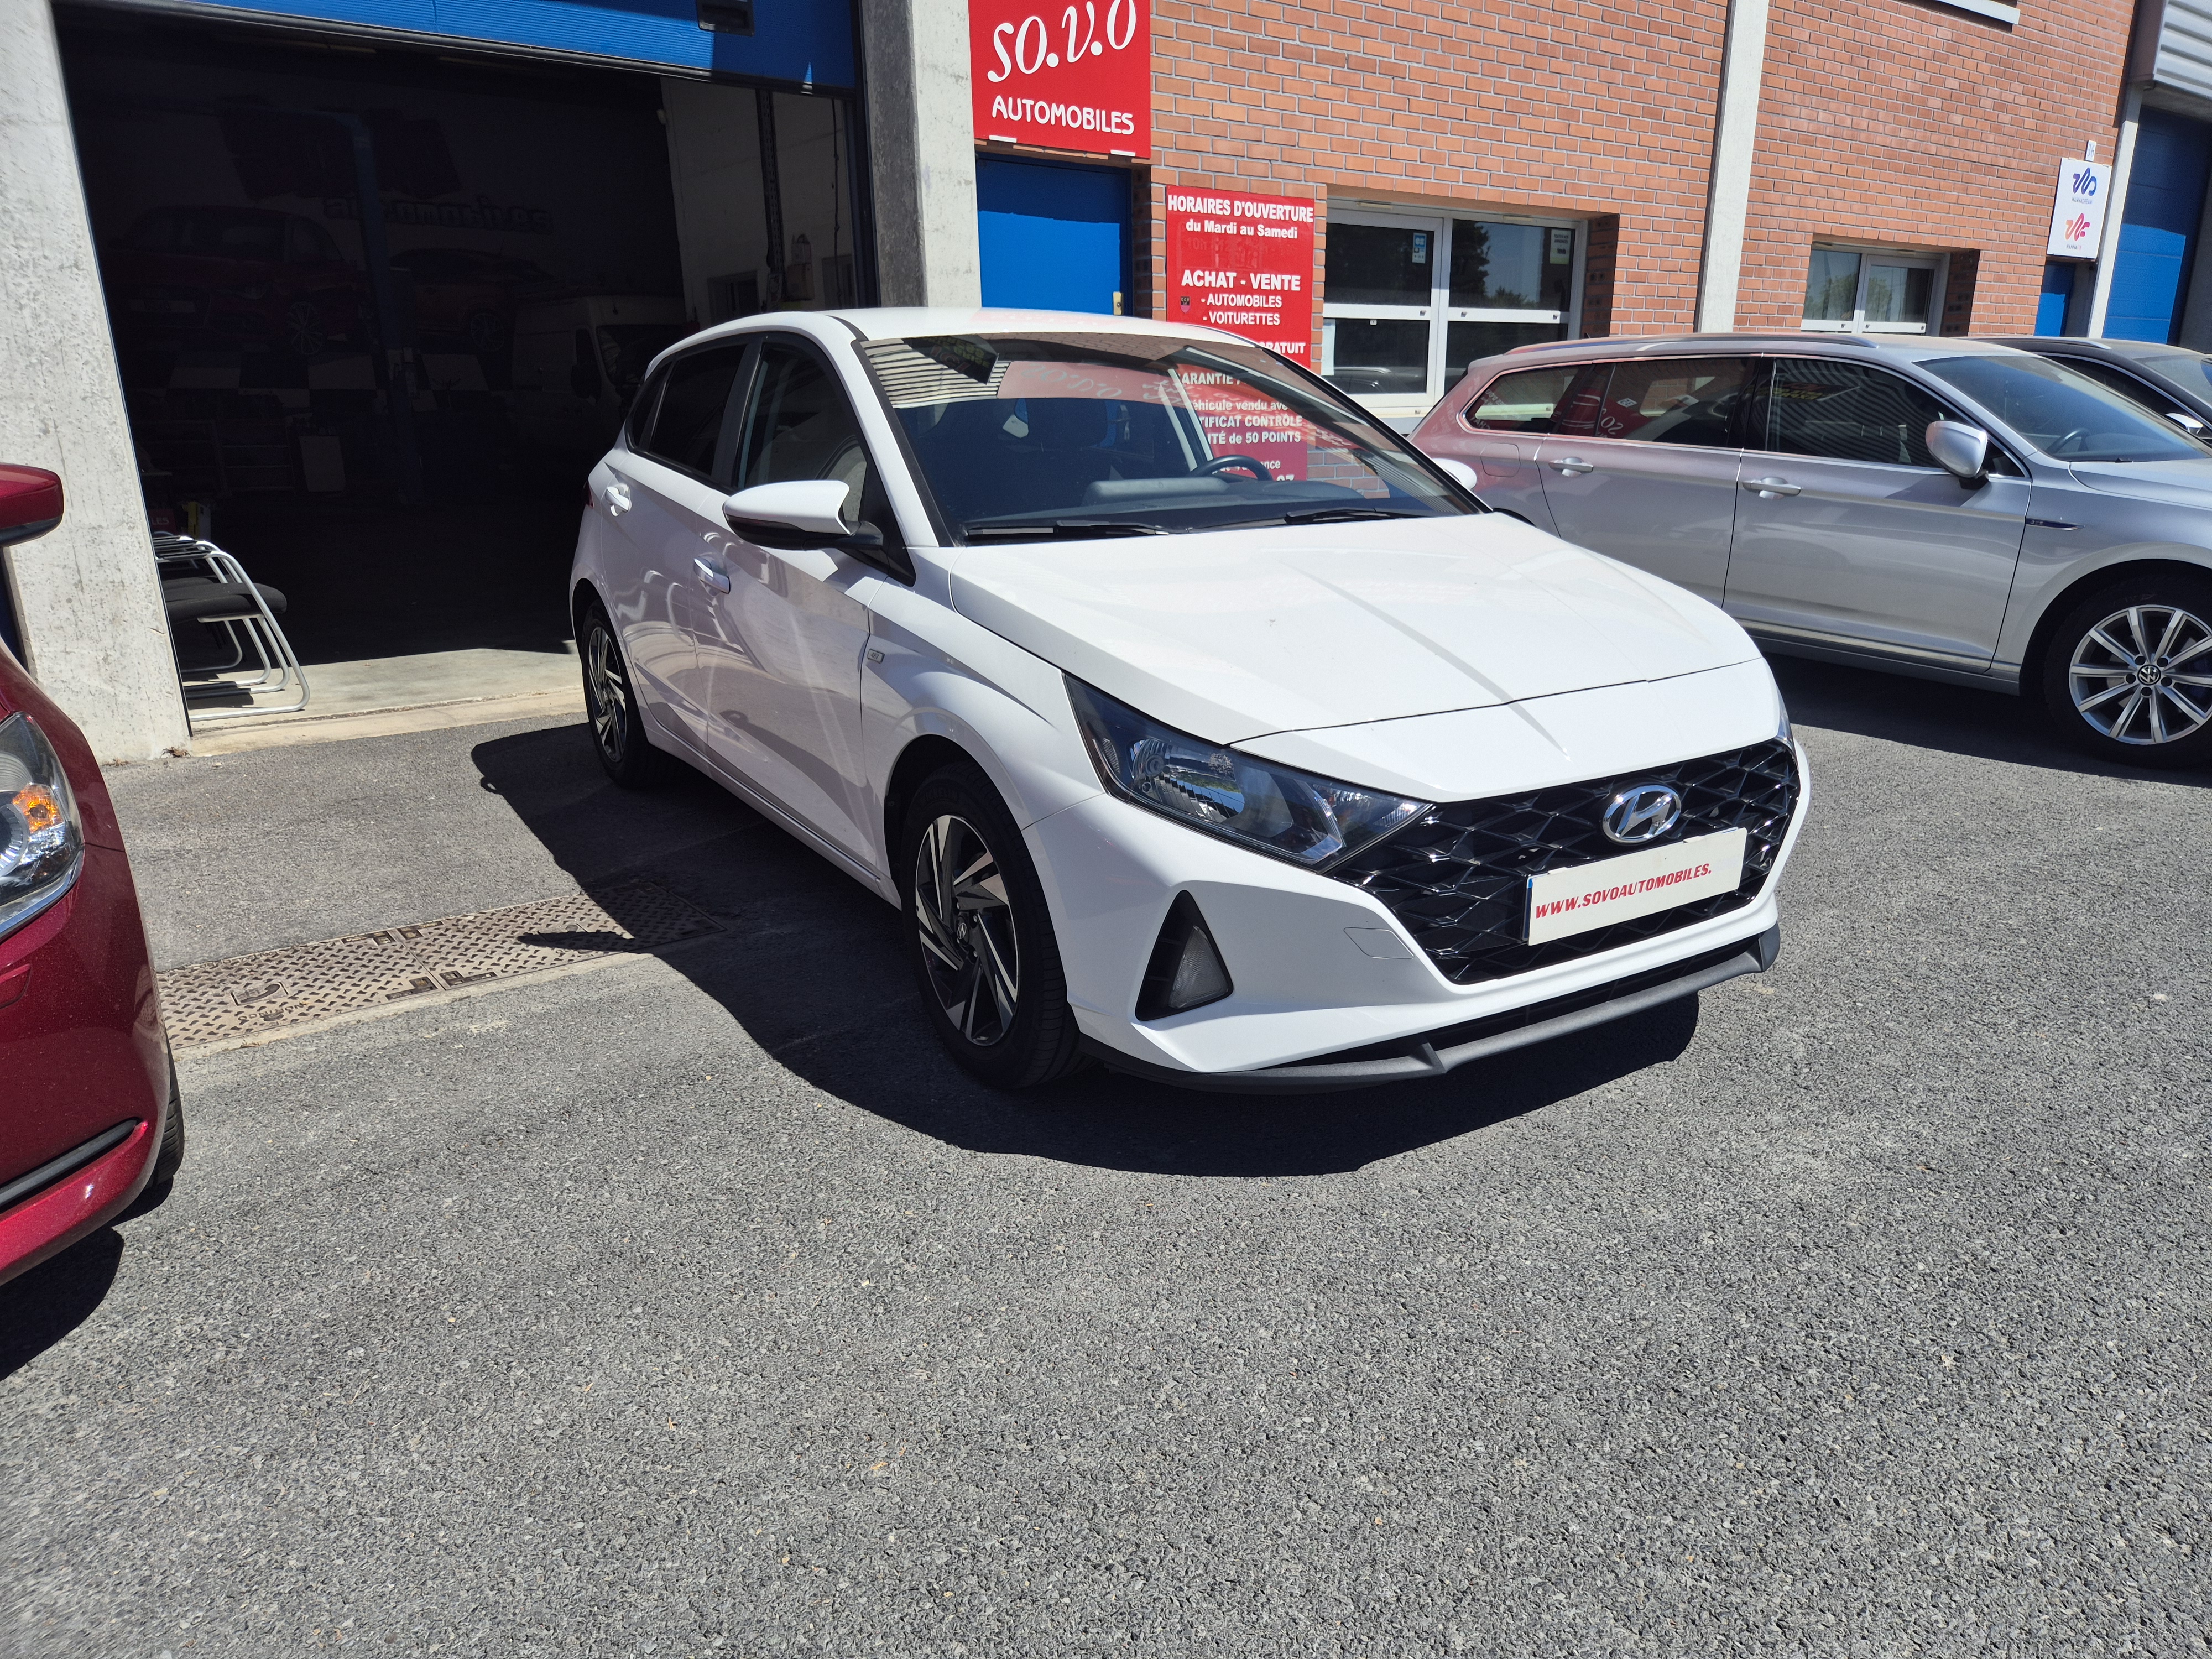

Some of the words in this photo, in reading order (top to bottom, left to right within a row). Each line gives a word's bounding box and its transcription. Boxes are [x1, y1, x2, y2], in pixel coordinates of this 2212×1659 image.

[992, 95, 1134, 135] AUTOMOBILES
[1168, 194, 1230, 216] HORAIRES
[1234, 202, 1313, 222] D'OUVERTURE
[1186, 219, 1201, 232] du
[1204, 220, 1237, 236] Mardi
[1240, 225, 1254, 236] au
[1257, 224, 1298, 239] Samedi
[1181, 270, 1237, 288] ACHAT
[1250, 273, 1301, 291] VENTE
[1179, 372, 1234, 385] ARANTIE
[1191, 399, 1232, 411] éhicule
[1235, 399, 1268, 411] vendu
[1270, 401, 1289, 411] ave
[1199, 415, 1242, 428] TIFICAT
[1245, 413, 1303, 427] CONTRÔLE
[1229, 432, 1243, 444] de
[1245, 432, 1259, 444] 50
[1261, 431, 1301, 444] POINTS
[1535, 863, 1712, 919] WWW.SOVOAUTOMOBILES.
